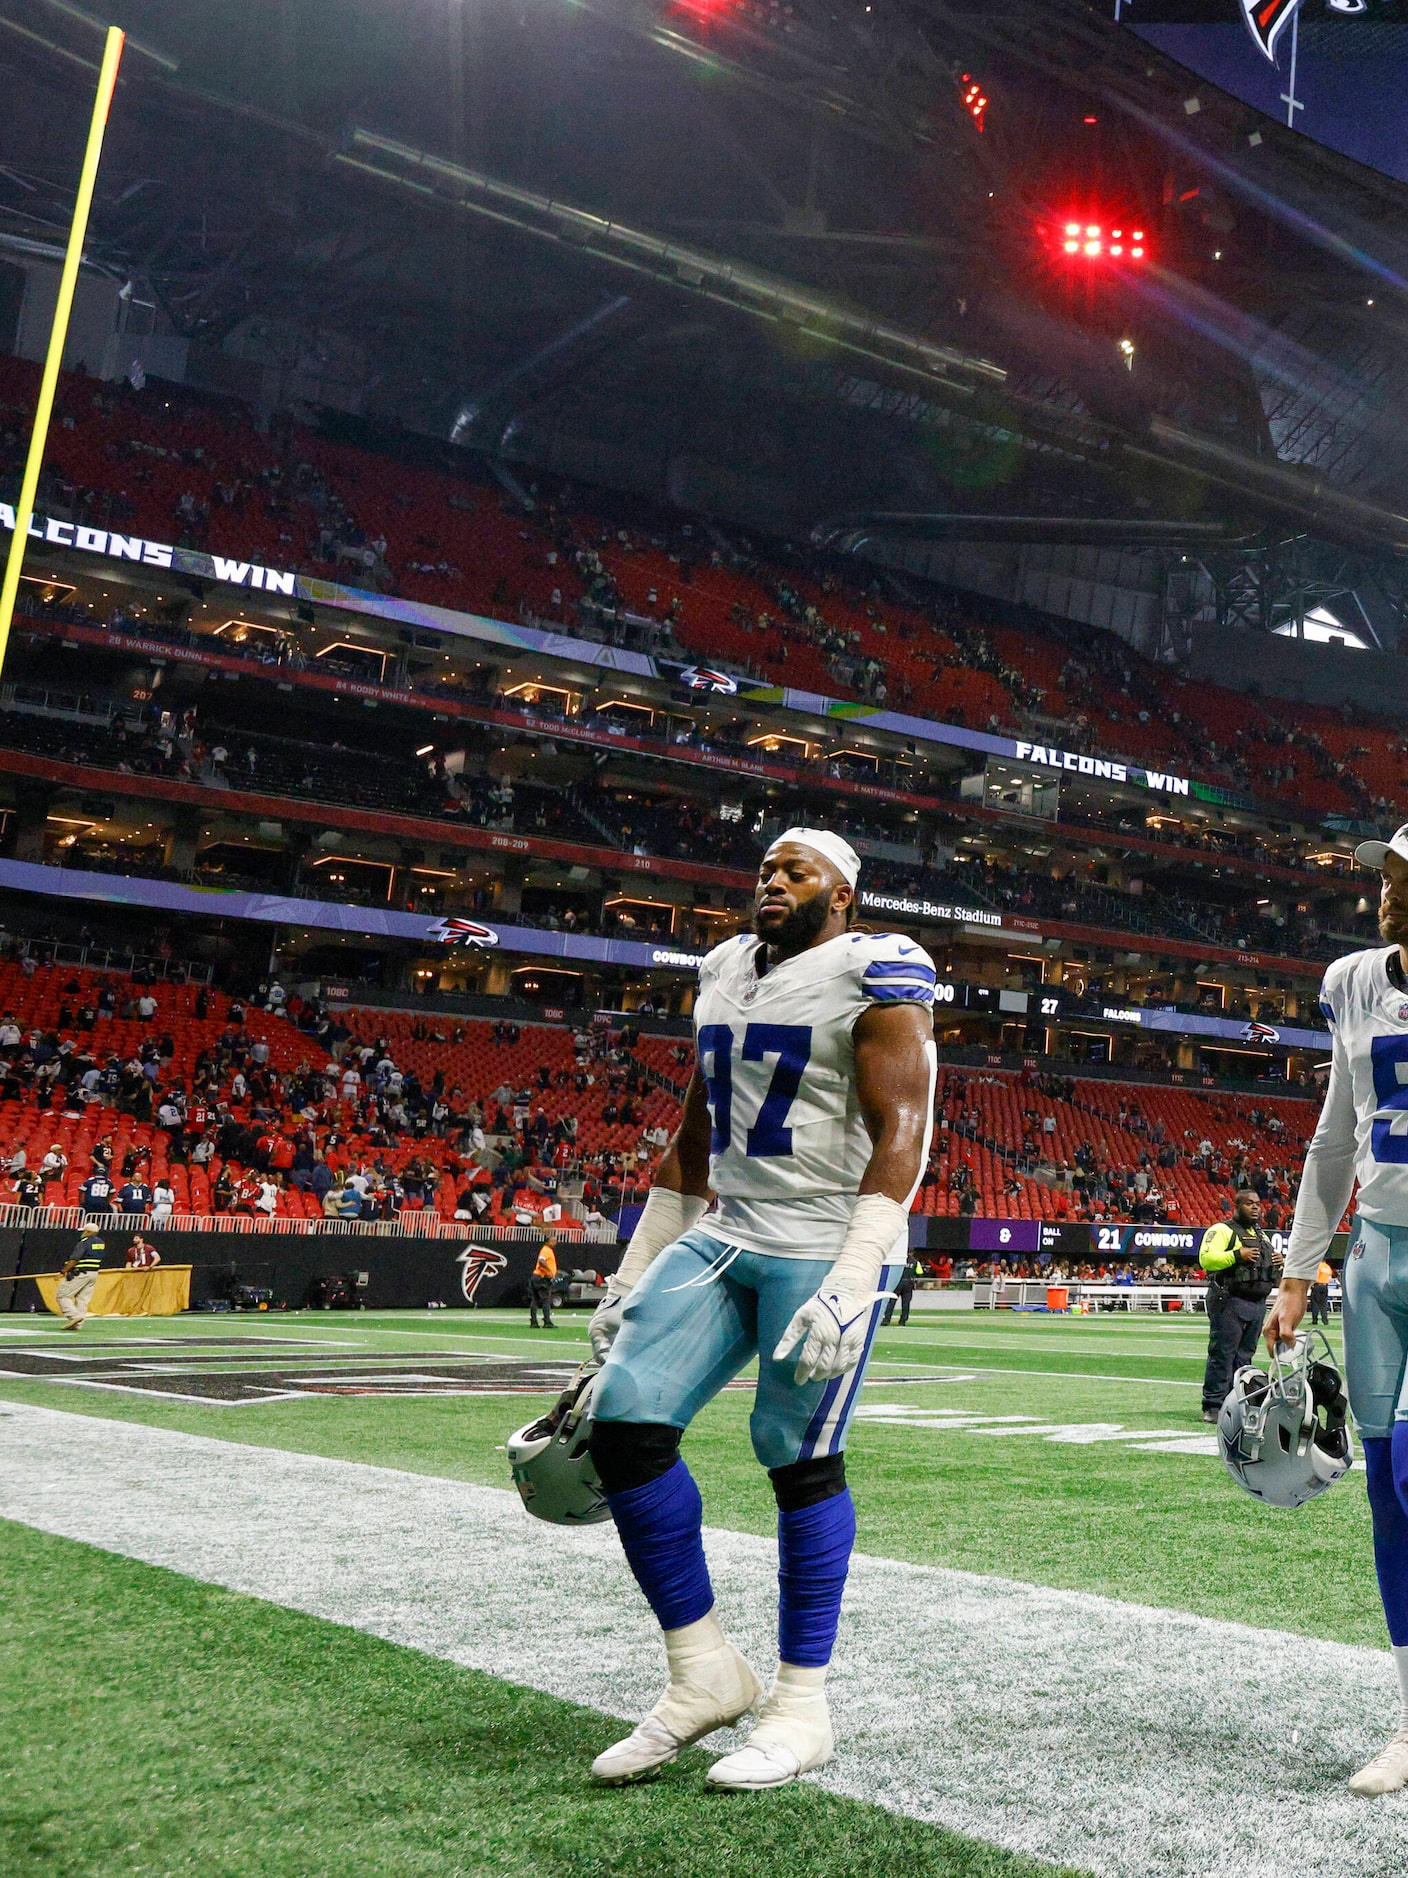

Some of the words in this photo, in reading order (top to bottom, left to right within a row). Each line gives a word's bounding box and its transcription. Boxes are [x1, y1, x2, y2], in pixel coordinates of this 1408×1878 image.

[0, 502, 174, 568] ALCONS
[211, 555, 296, 595] WIN
[126, 639, 172, 656] WARRICK
[174, 648, 203, 662] DUNN
[132, 689, 153, 701] 207
[350, 684, 380, 698] RODDY
[381, 690, 409, 703] WHITE
[539, 722, 559, 732] TODD
[561, 725, 596, 740] McCLURE
[701, 754, 730, 767] ARTHUR
[741, 761, 765, 773] BLANK
[1016, 741, 1127, 782] FALCONS
[1144, 770, 1189, 795] WIN
[492, 836, 529, 850] 208-209
[635, 859, 651, 869] 210
[861, 891, 951, 919] Mercedes-Benz
[954, 907, 1002, 927] Stadium
[653, 950, 703, 967] COWBOY
[1040, 997, 1059, 1015] 27
[1103, 1007, 1142, 1023] FALCONS
[195, 1112, 205, 1122] 21
[268, 1142, 274, 1153] 7
[329, 1135, 337, 1145] 5
[25, 1183, 39, 1194] 21
[90, 1184, 110, 1197] 88
[132, 1188, 143, 1200] 11
[998, 1227, 1012, 1243] &
[1042, 1227, 1062, 1237] BALL
[1098, 1228, 1121, 1250] 21
[1134, 1231, 1194, 1248] COWBOYS
[1042, 1237, 1055, 1247] ON
